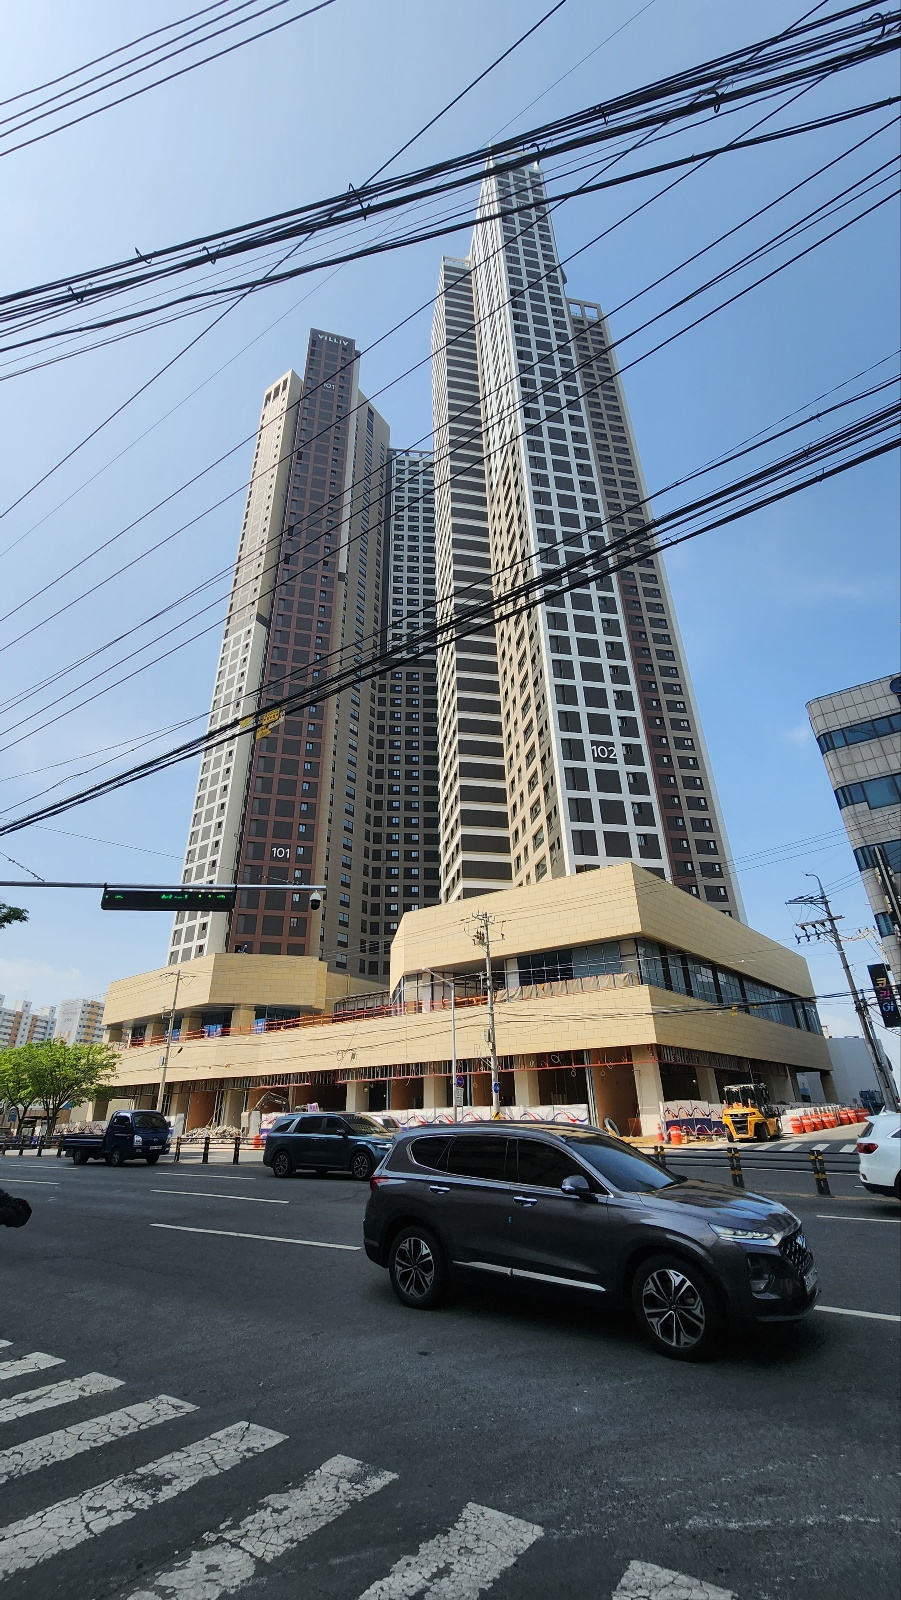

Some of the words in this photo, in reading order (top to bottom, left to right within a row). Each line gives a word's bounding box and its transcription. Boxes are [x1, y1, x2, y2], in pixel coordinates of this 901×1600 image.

[317, 333, 349, 346] VILLIV
[591, 745, 618, 759] 102
[271, 847, 290, 859] 101
